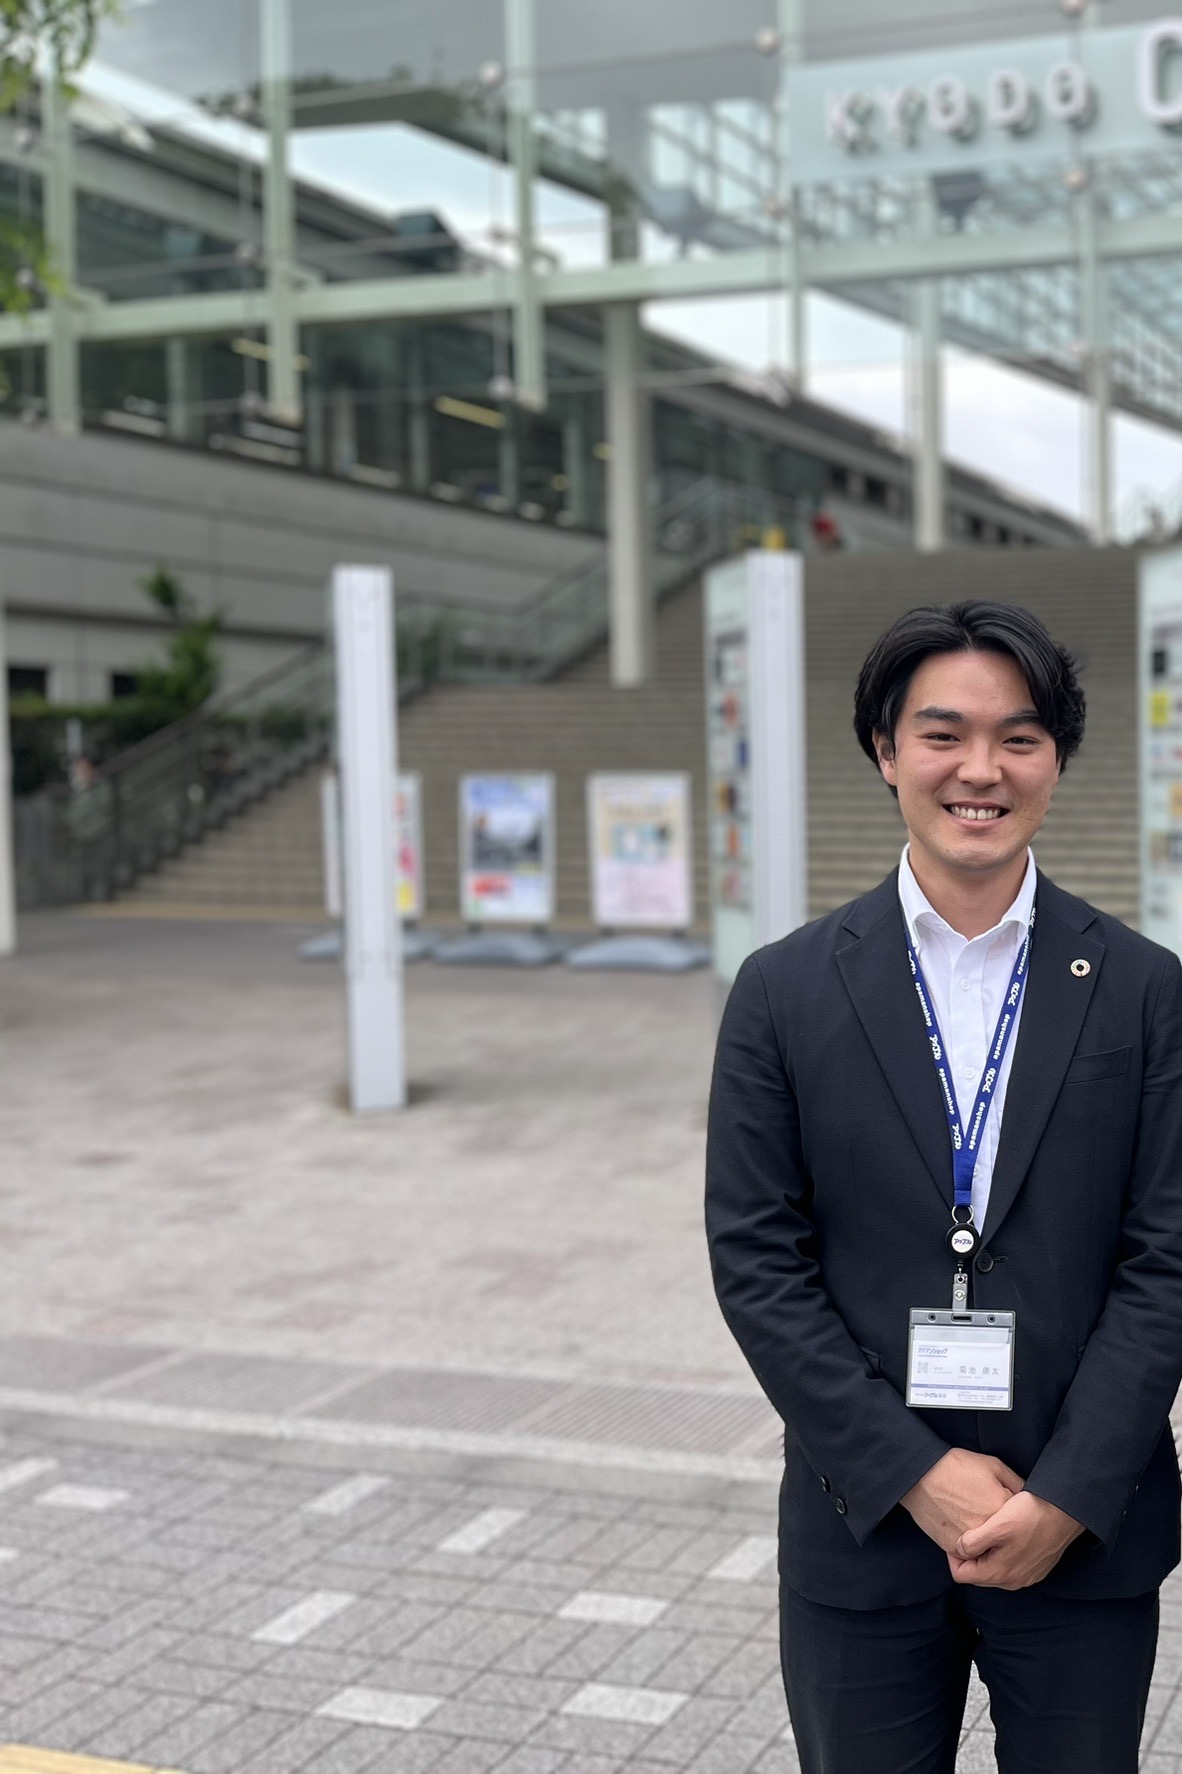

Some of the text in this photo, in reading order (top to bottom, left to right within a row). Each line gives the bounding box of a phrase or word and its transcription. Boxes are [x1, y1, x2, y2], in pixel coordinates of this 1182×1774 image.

[825, 63, 1092, 150] KYODO
[915, 982, 932, 1027] apamanshop
[993, 1013, 1011, 1060] apamanshop
[938, 1068, 955, 1115] apamanshop
[968, 1101, 986, 1150] apamanshop
